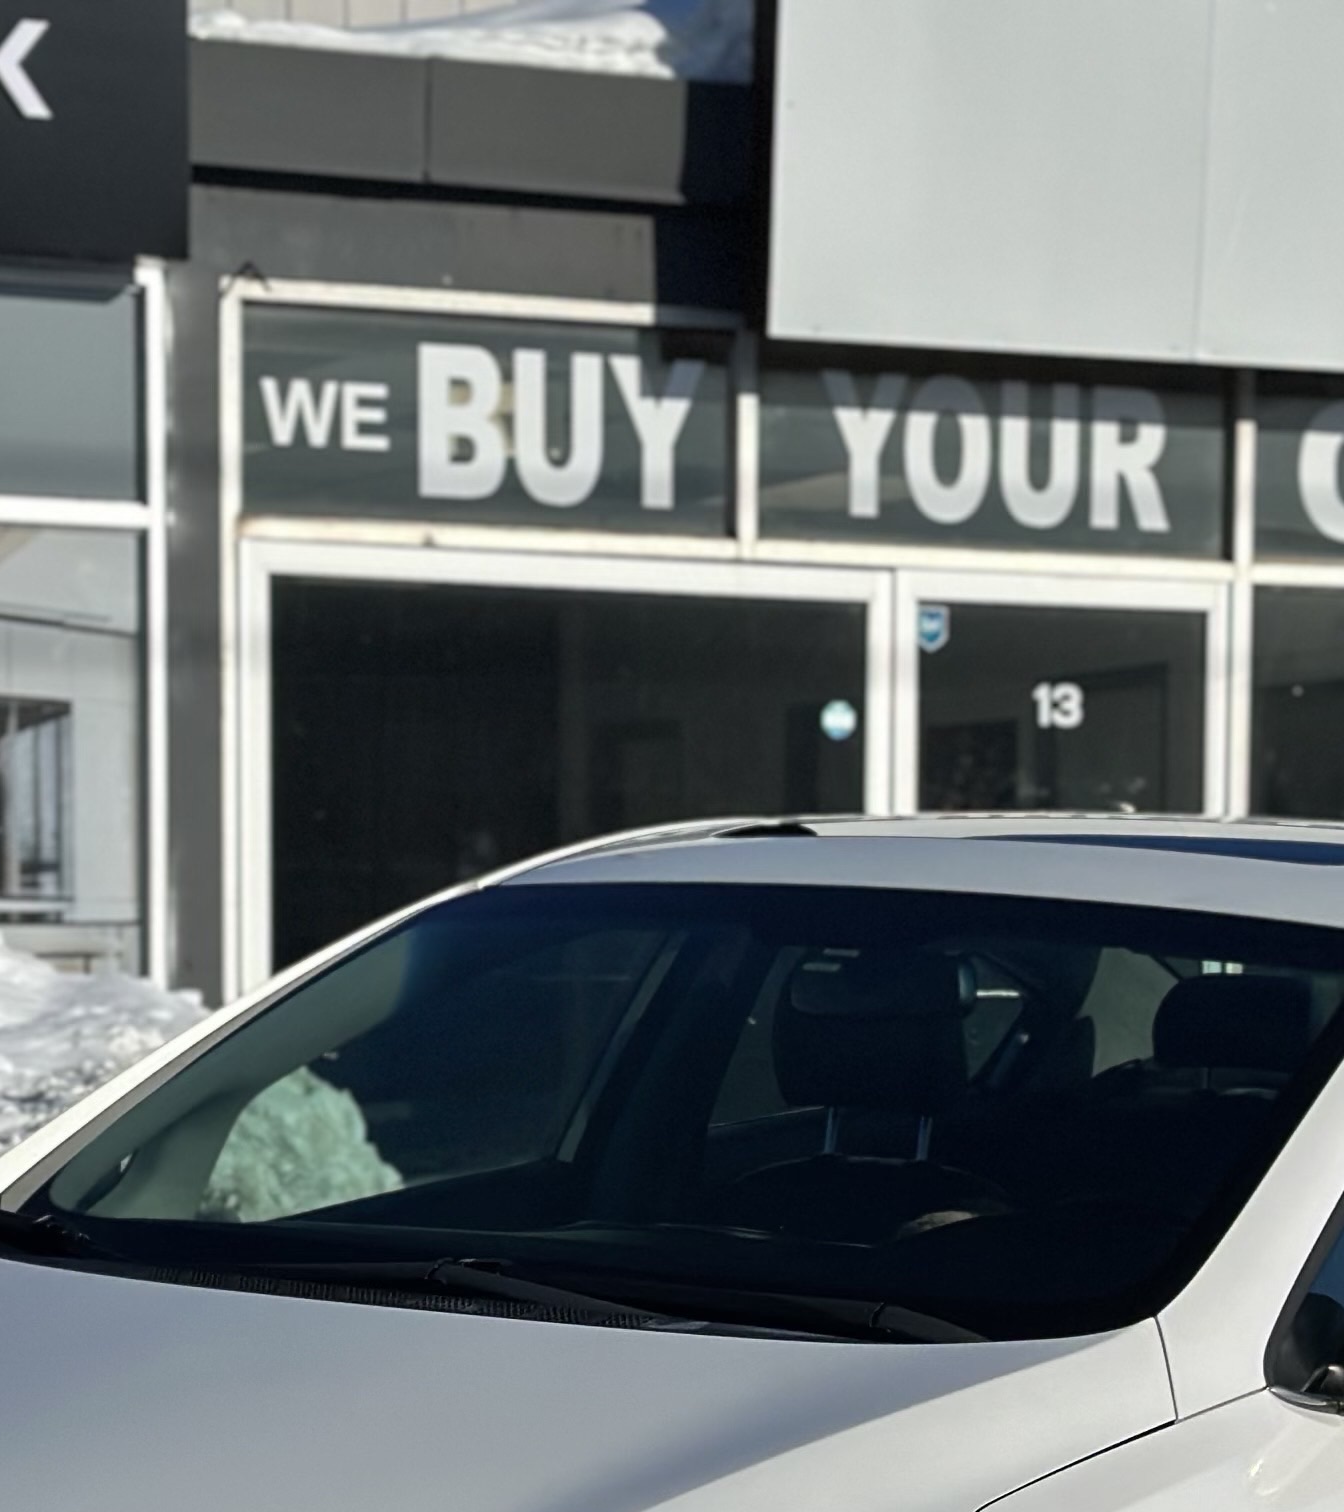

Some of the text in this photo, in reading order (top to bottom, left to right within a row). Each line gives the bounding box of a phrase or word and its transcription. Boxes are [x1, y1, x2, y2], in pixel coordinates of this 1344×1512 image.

[259, 376, 391, 453] WE
[416, 342, 707, 511] BUY
[821, 368, 1171, 535] YOUR
[1031, 680, 1085, 731] 13
